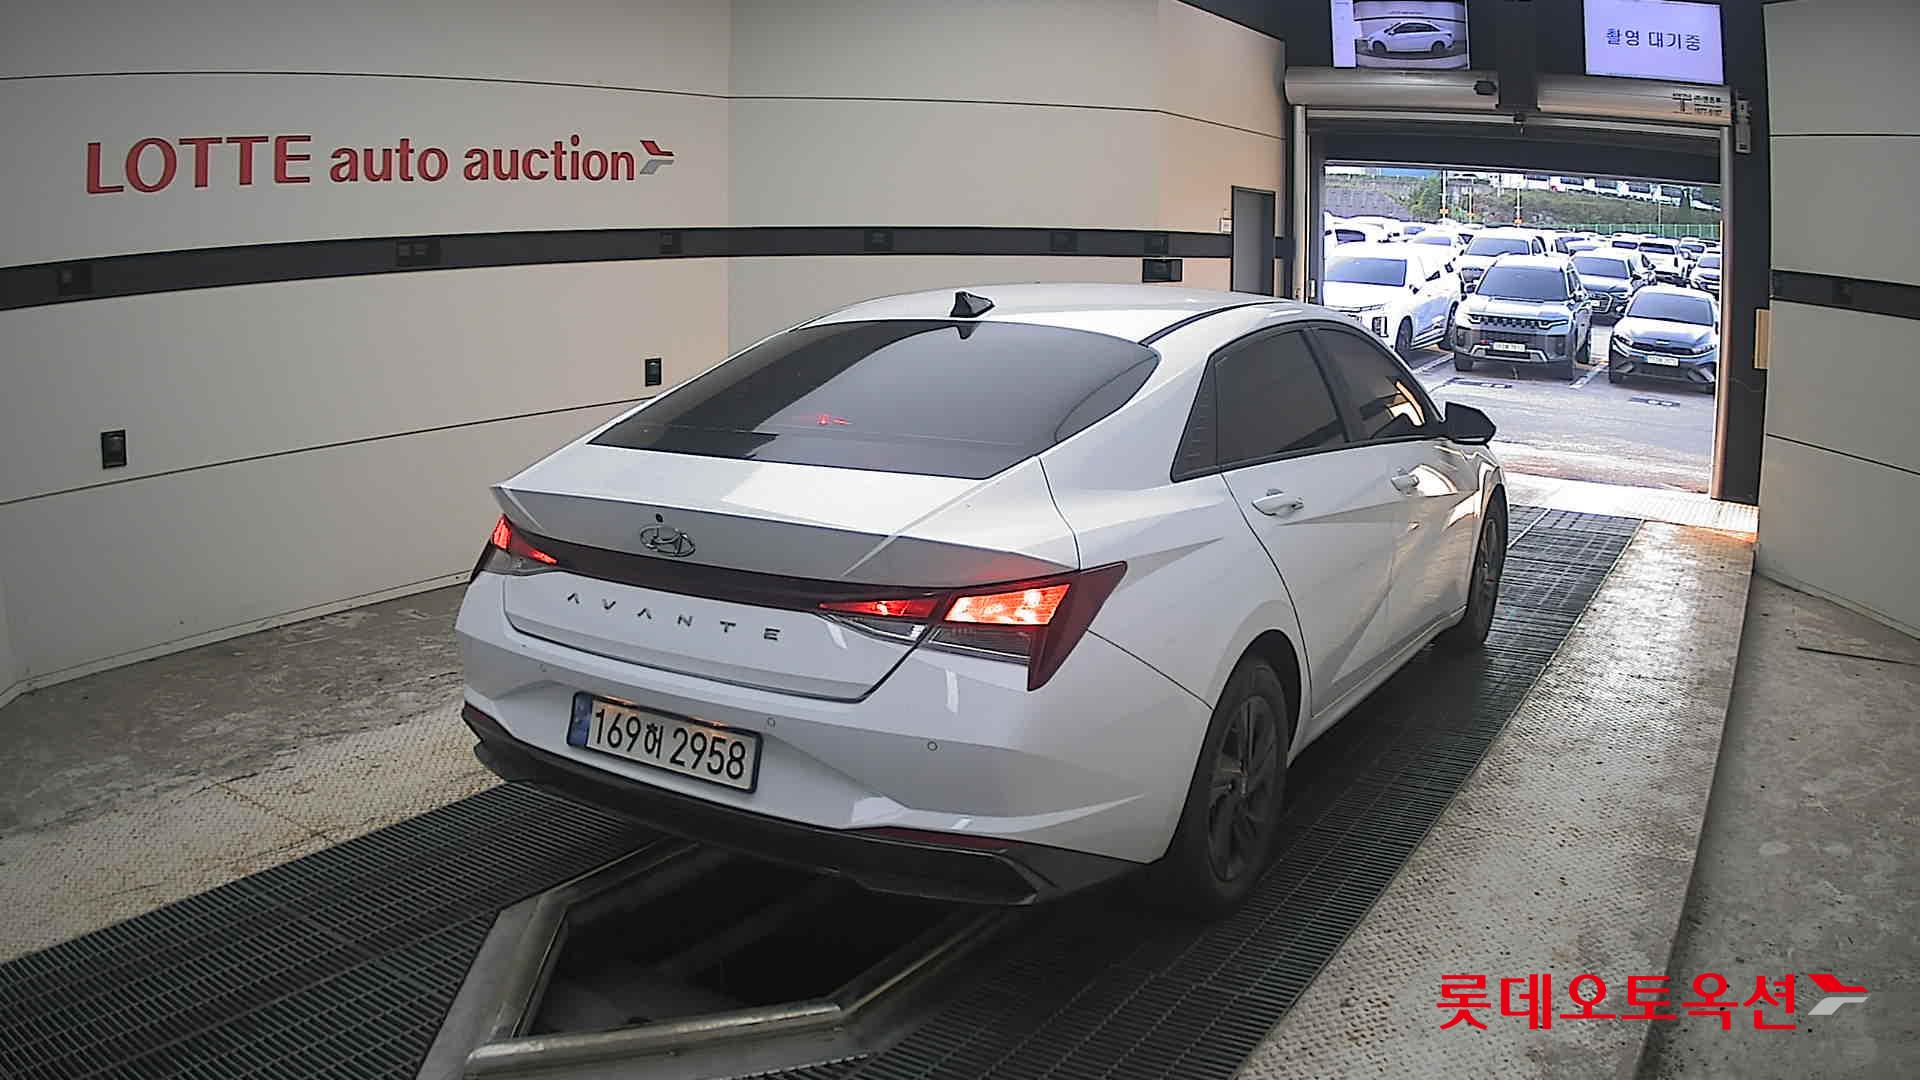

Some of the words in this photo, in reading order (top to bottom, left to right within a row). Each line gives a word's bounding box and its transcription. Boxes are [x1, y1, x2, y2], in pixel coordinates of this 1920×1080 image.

[1606, 27, 1640, 47] 촬영
[1647, 31, 1701, 52] 대기중
[86, 134, 312, 195] LOTTE
[329, 138, 449, 183] auto
[463, 134, 636, 182] auction
[567, 592, 781, 641] AVANTE
[595, 708, 664, 760] 169허
[670, 727, 747, 780] 2958
